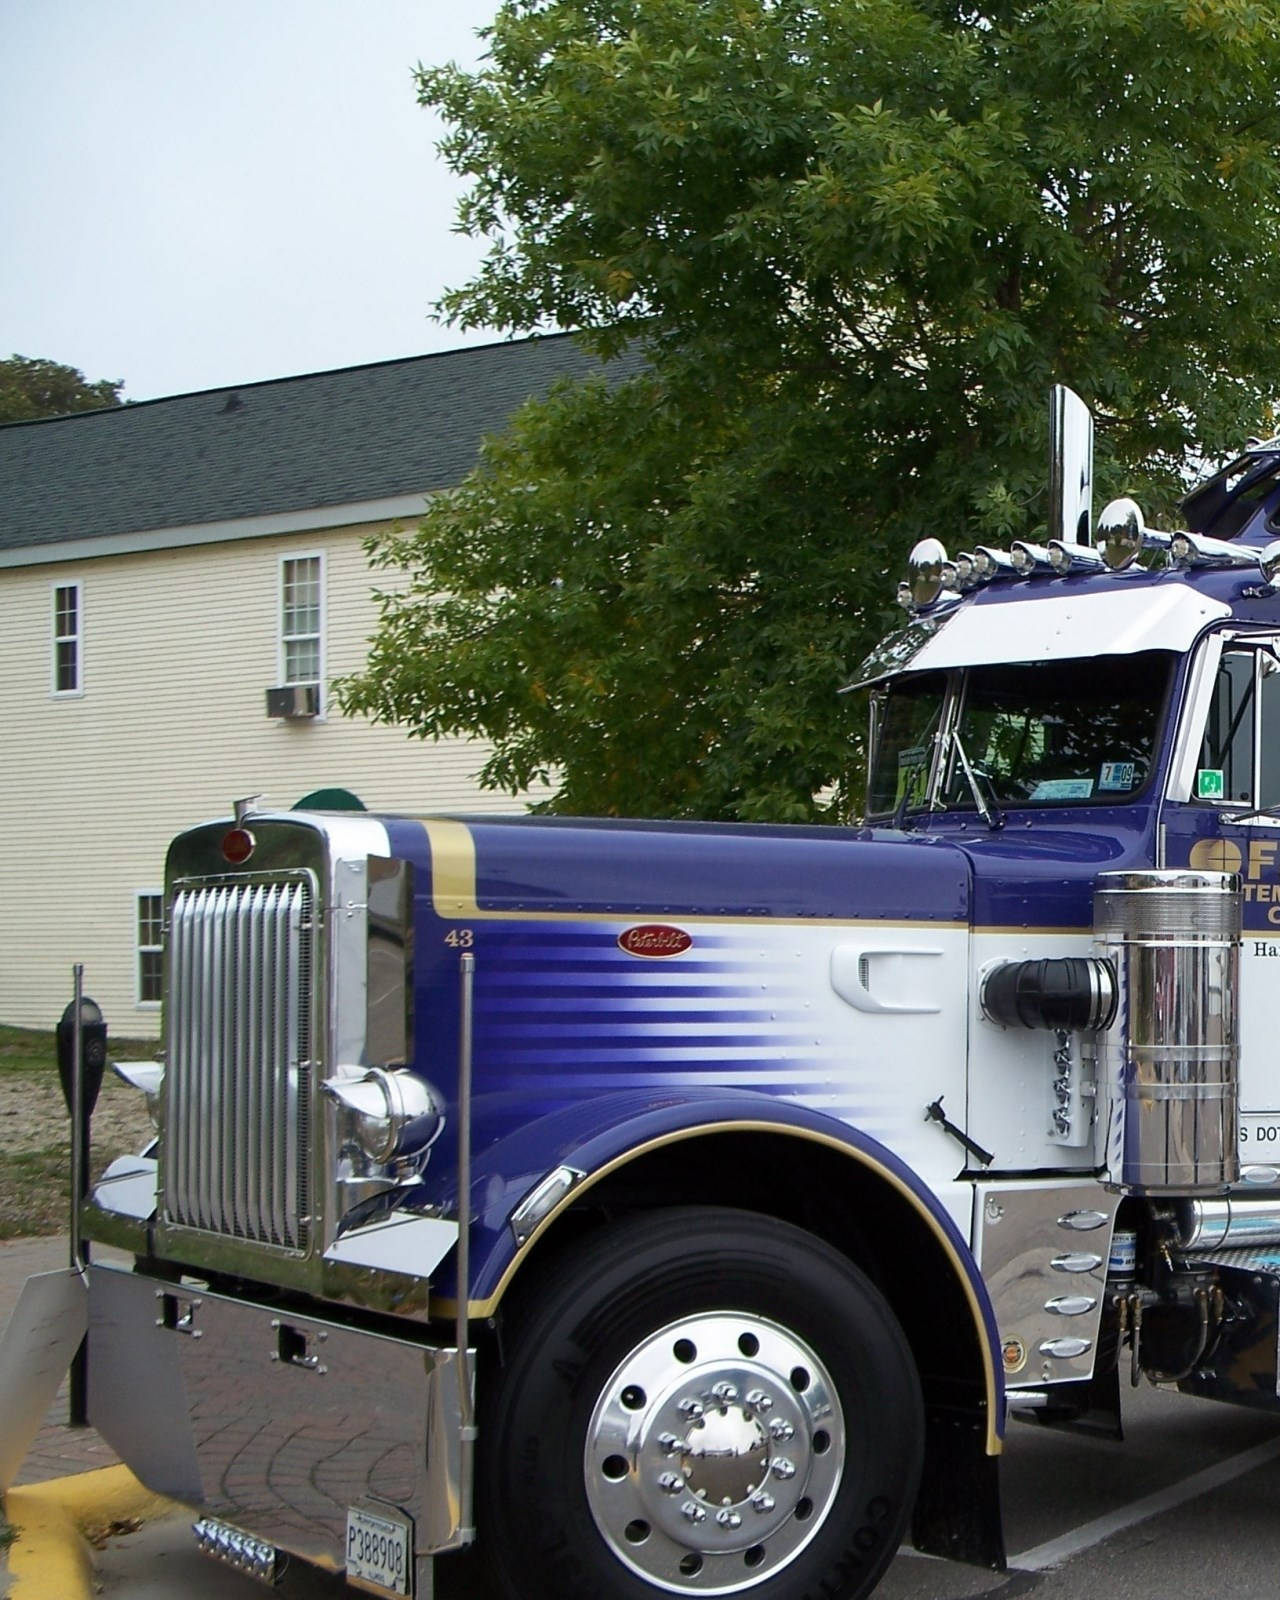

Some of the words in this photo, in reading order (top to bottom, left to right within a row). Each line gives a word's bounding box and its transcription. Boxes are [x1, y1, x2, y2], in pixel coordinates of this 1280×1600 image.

[1104, 765, 1112, 781] 7
[1120, 764, 1132, 782] 09
[444, 929, 474, 948] 43
[1239, 1126, 1249, 1142] S
